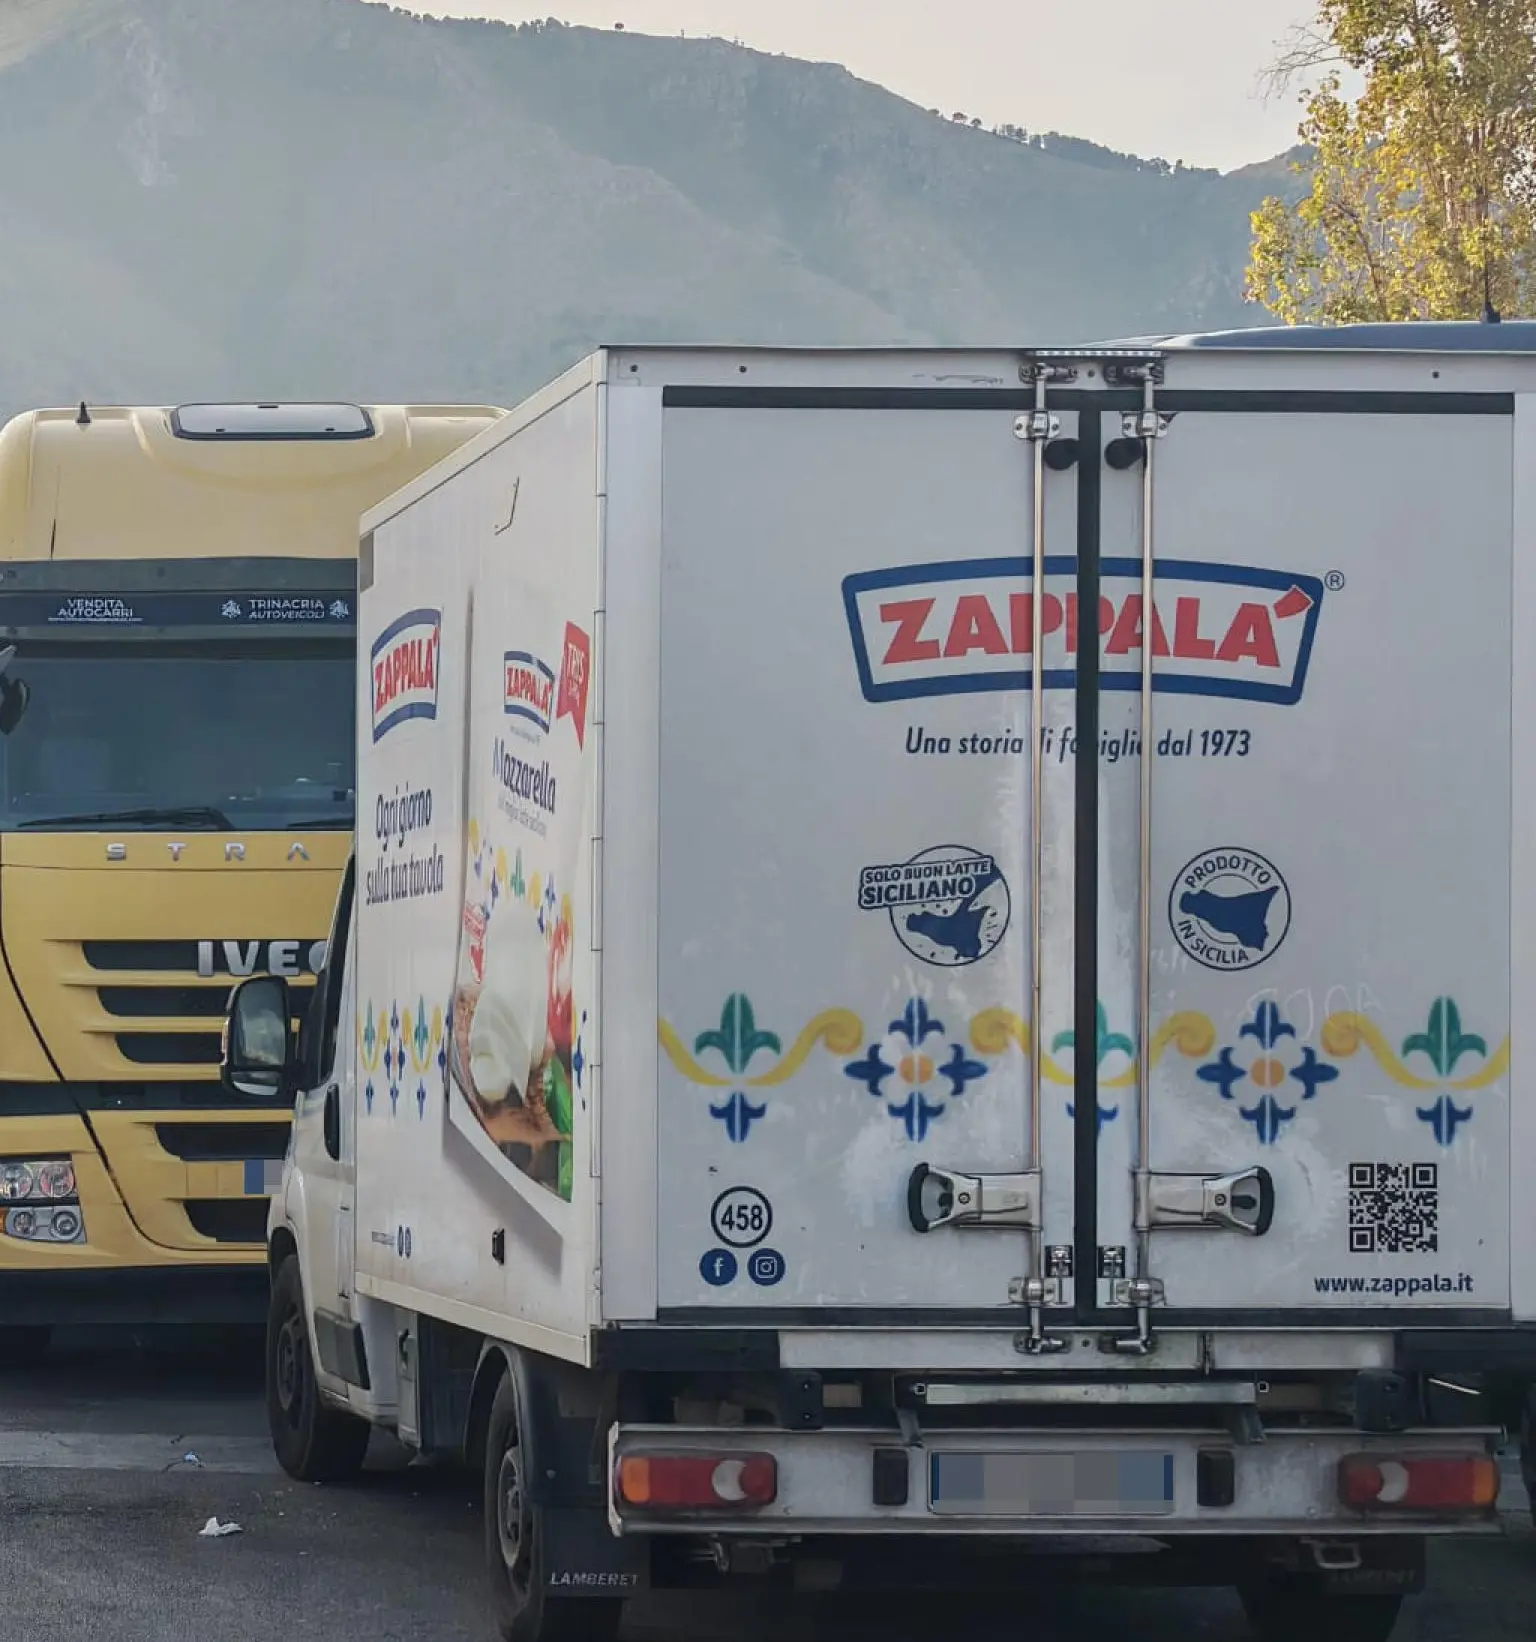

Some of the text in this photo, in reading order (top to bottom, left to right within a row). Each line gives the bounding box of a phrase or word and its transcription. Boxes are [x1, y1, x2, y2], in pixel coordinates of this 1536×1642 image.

[57, 608, 133, 618] AUTOCARRI
[67, 599, 124, 608] VENDITA
[248, 599, 324, 609] TRINACRIA
[248, 610, 325, 619] AUTOVEICOLI
[905, 726, 951, 755] Una
[958, 728, 1024, 755] storia
[1157, 728, 1193, 757] dal
[1199, 728, 1252, 757] 1973
[492, 737, 557, 815] Mozzarella
[375, 785, 399, 852] Ogni
[399, 781, 433, 848] giorno
[106, 842, 311, 862] STRA
[366, 843, 444, 906] sulla tua tavola
[864, 861, 990, 885] SOLO BUON LATTE
[1184, 855, 1272, 889] PRODOTTO
[863, 877, 974, 905] SICILIANO
[1177, 920, 1249, 964] IN SICILIA
[720, 1204, 764, 1231] 458
[1313, 1272, 1474, 1297] www.zappala.it
[549, 1571, 640, 1586] LAMBERET
